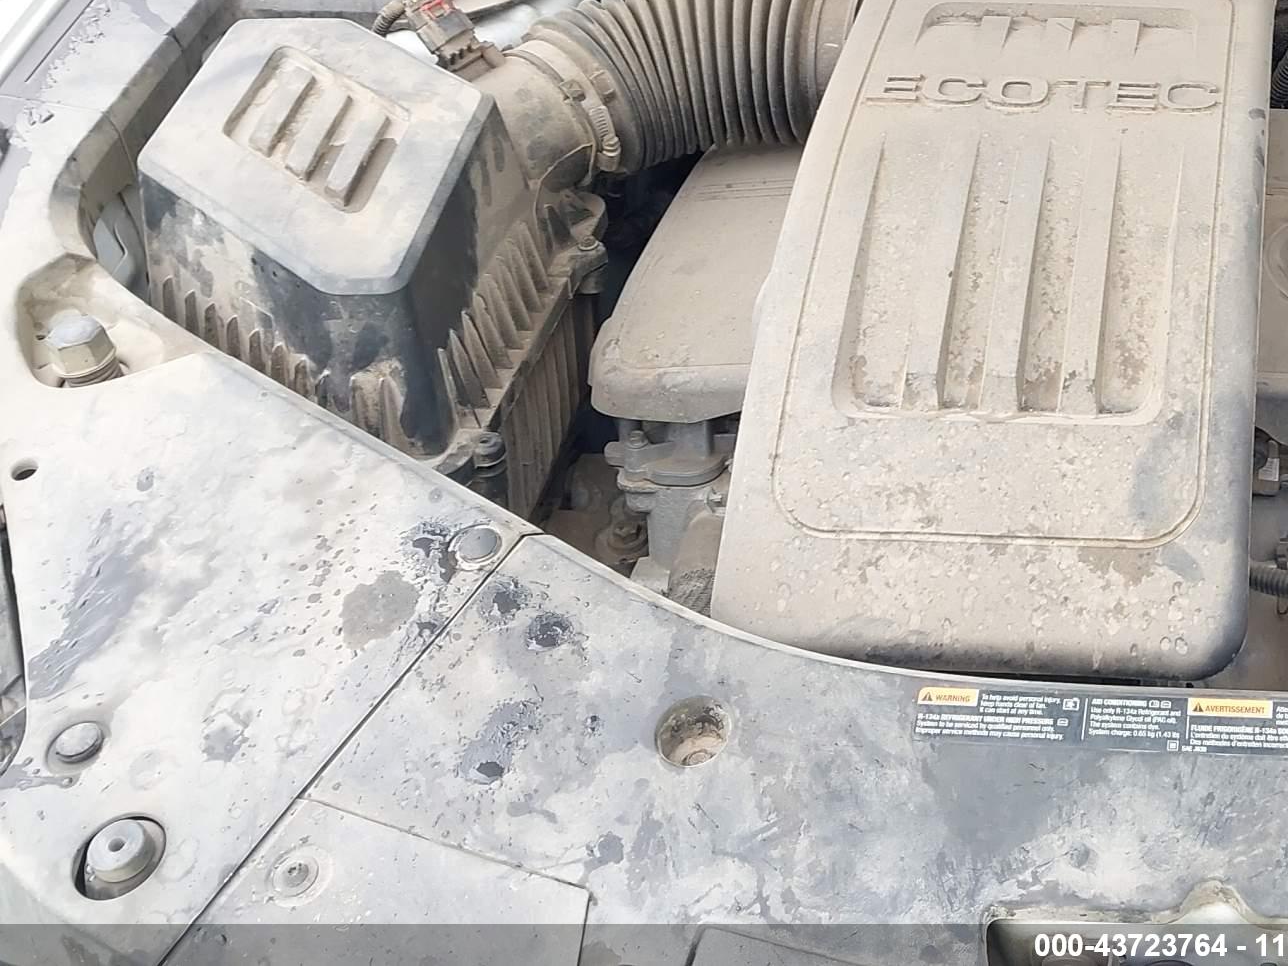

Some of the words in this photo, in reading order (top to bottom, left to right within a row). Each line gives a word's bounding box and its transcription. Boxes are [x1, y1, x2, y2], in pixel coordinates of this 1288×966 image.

[865, 74, 1222, 112] ECOTEC
[935, 694, 970, 702] WARNING
[1206, 705, 1264, 714] AVERTISSEMENT
